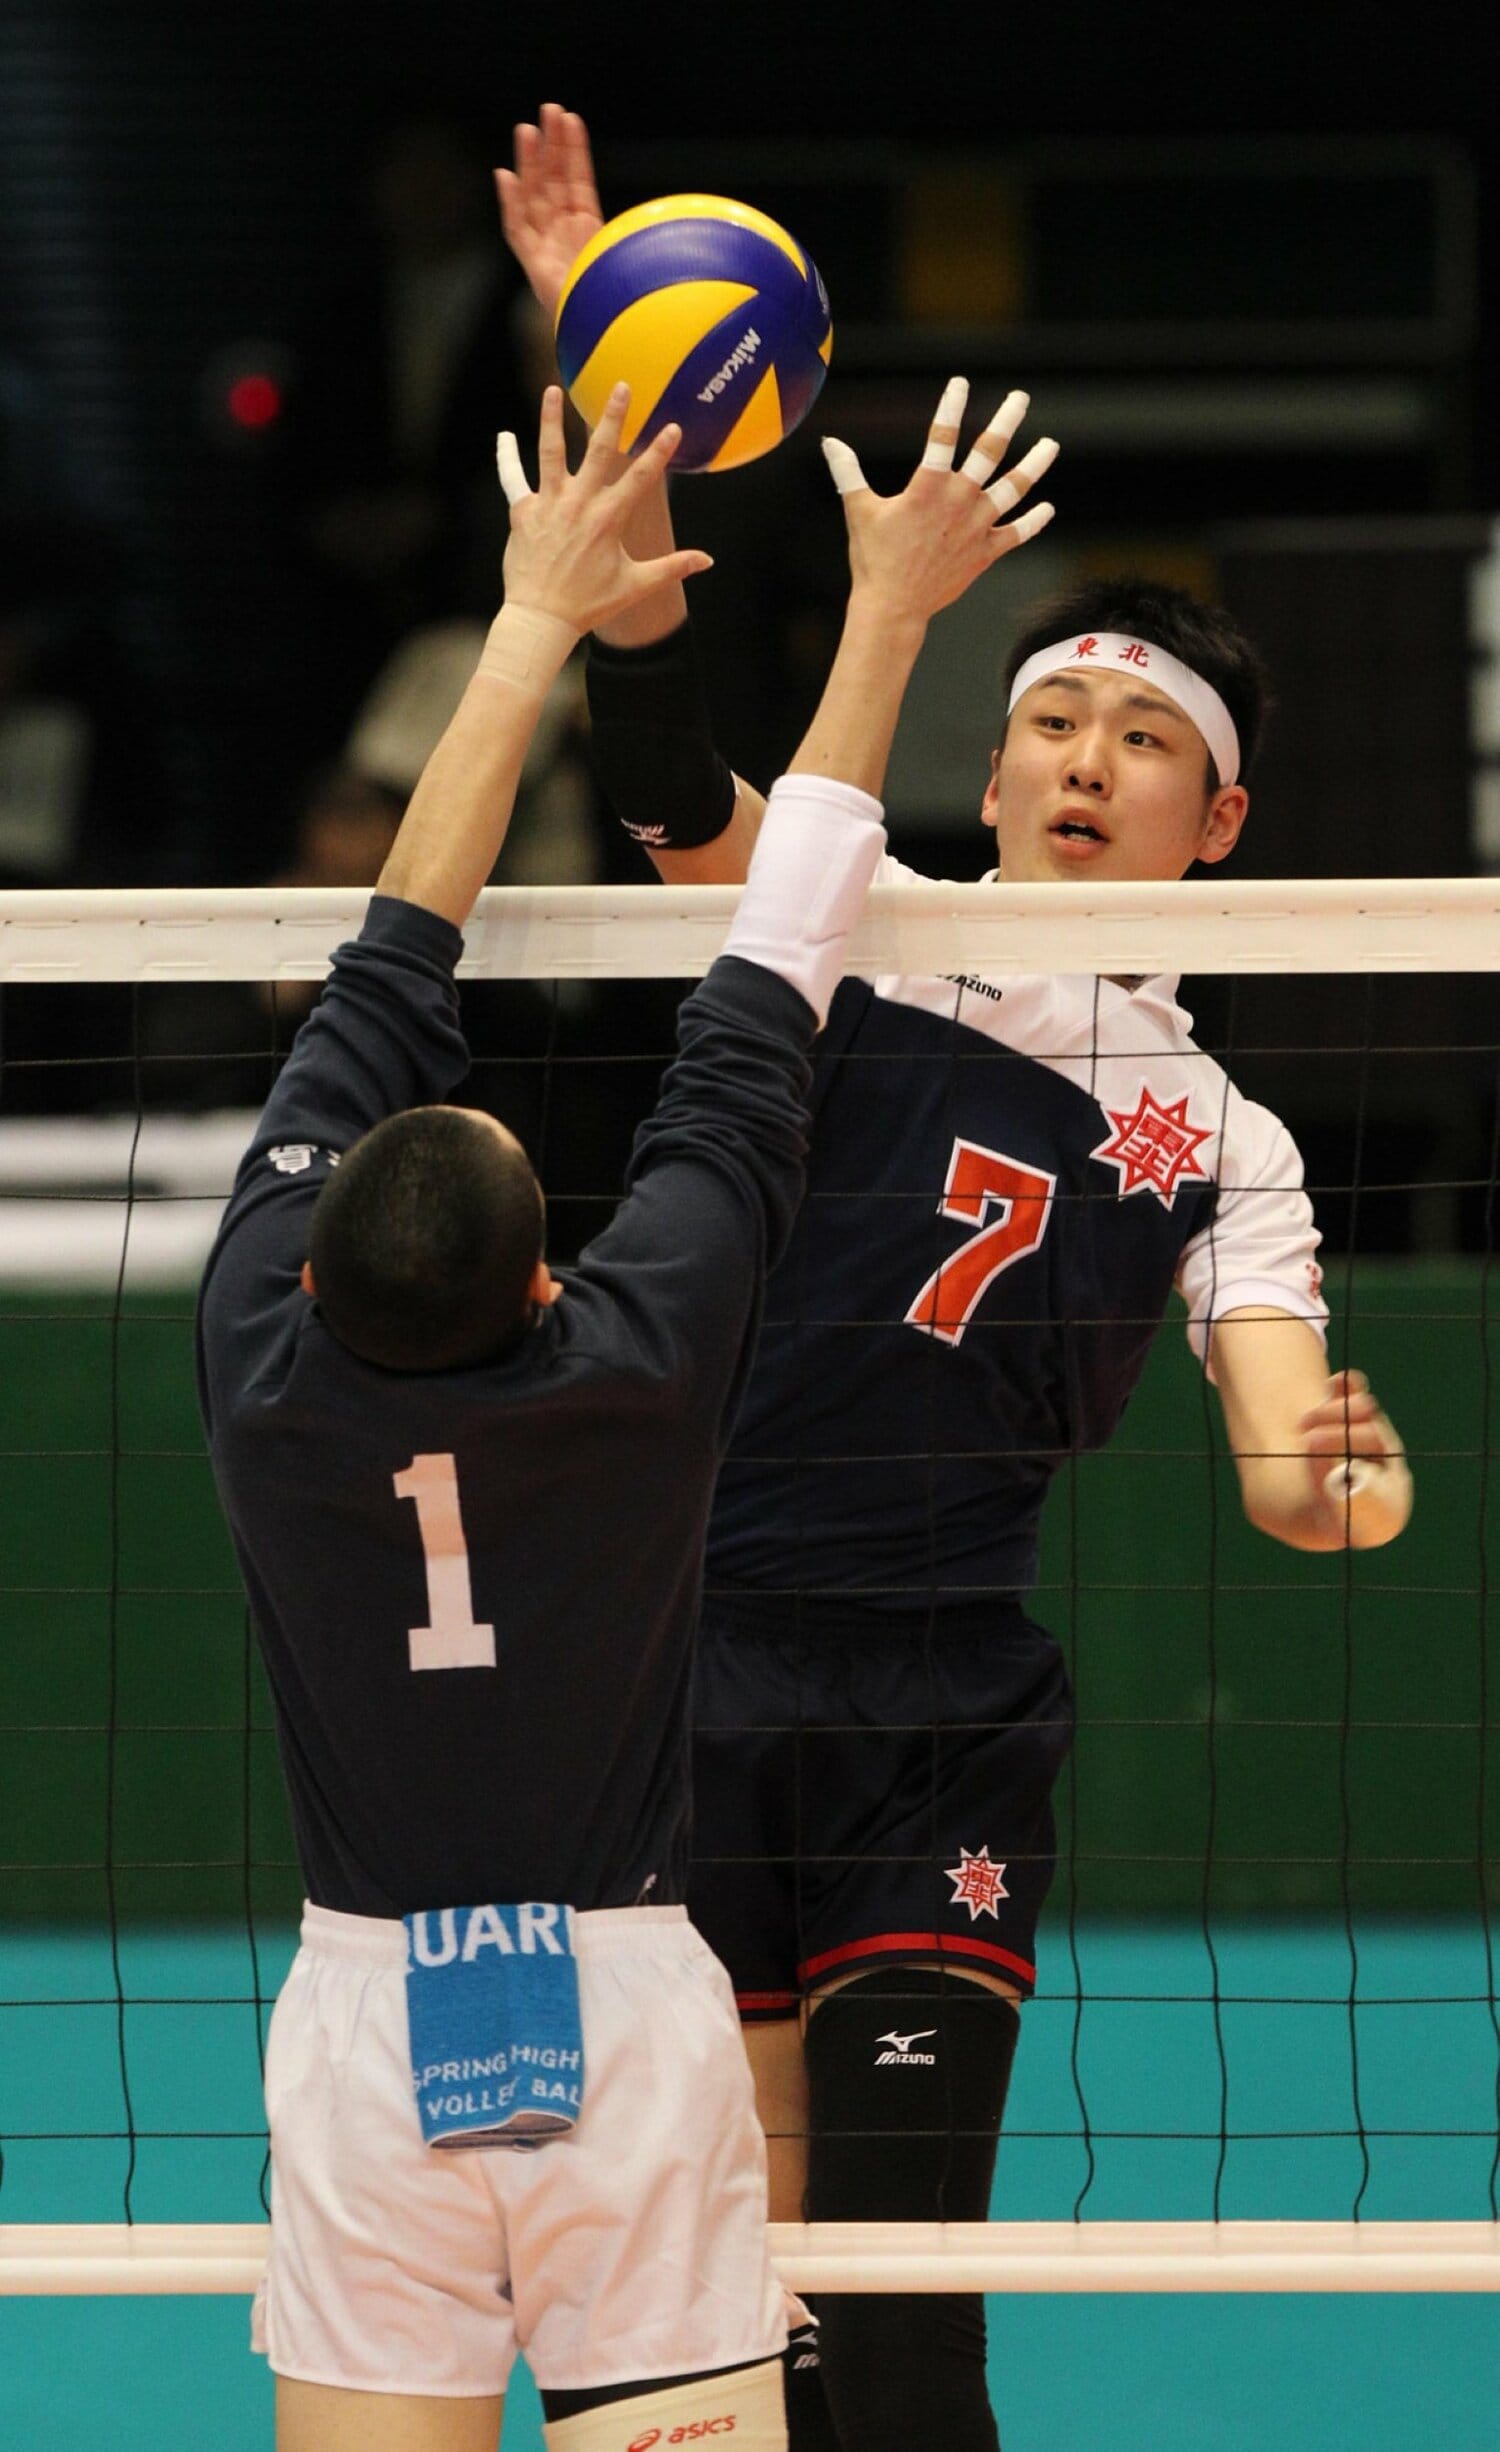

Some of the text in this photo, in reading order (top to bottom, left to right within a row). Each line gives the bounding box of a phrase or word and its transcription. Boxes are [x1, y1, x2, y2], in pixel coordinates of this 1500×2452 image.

[1068, 636, 1150, 668] 東北
[903, 1136, 1057, 1347] 7
[392, 1453, 497, 1671] 1
[511, 2045, 580, 2071] HIGH
[667, 2414, 736, 2444] asics
